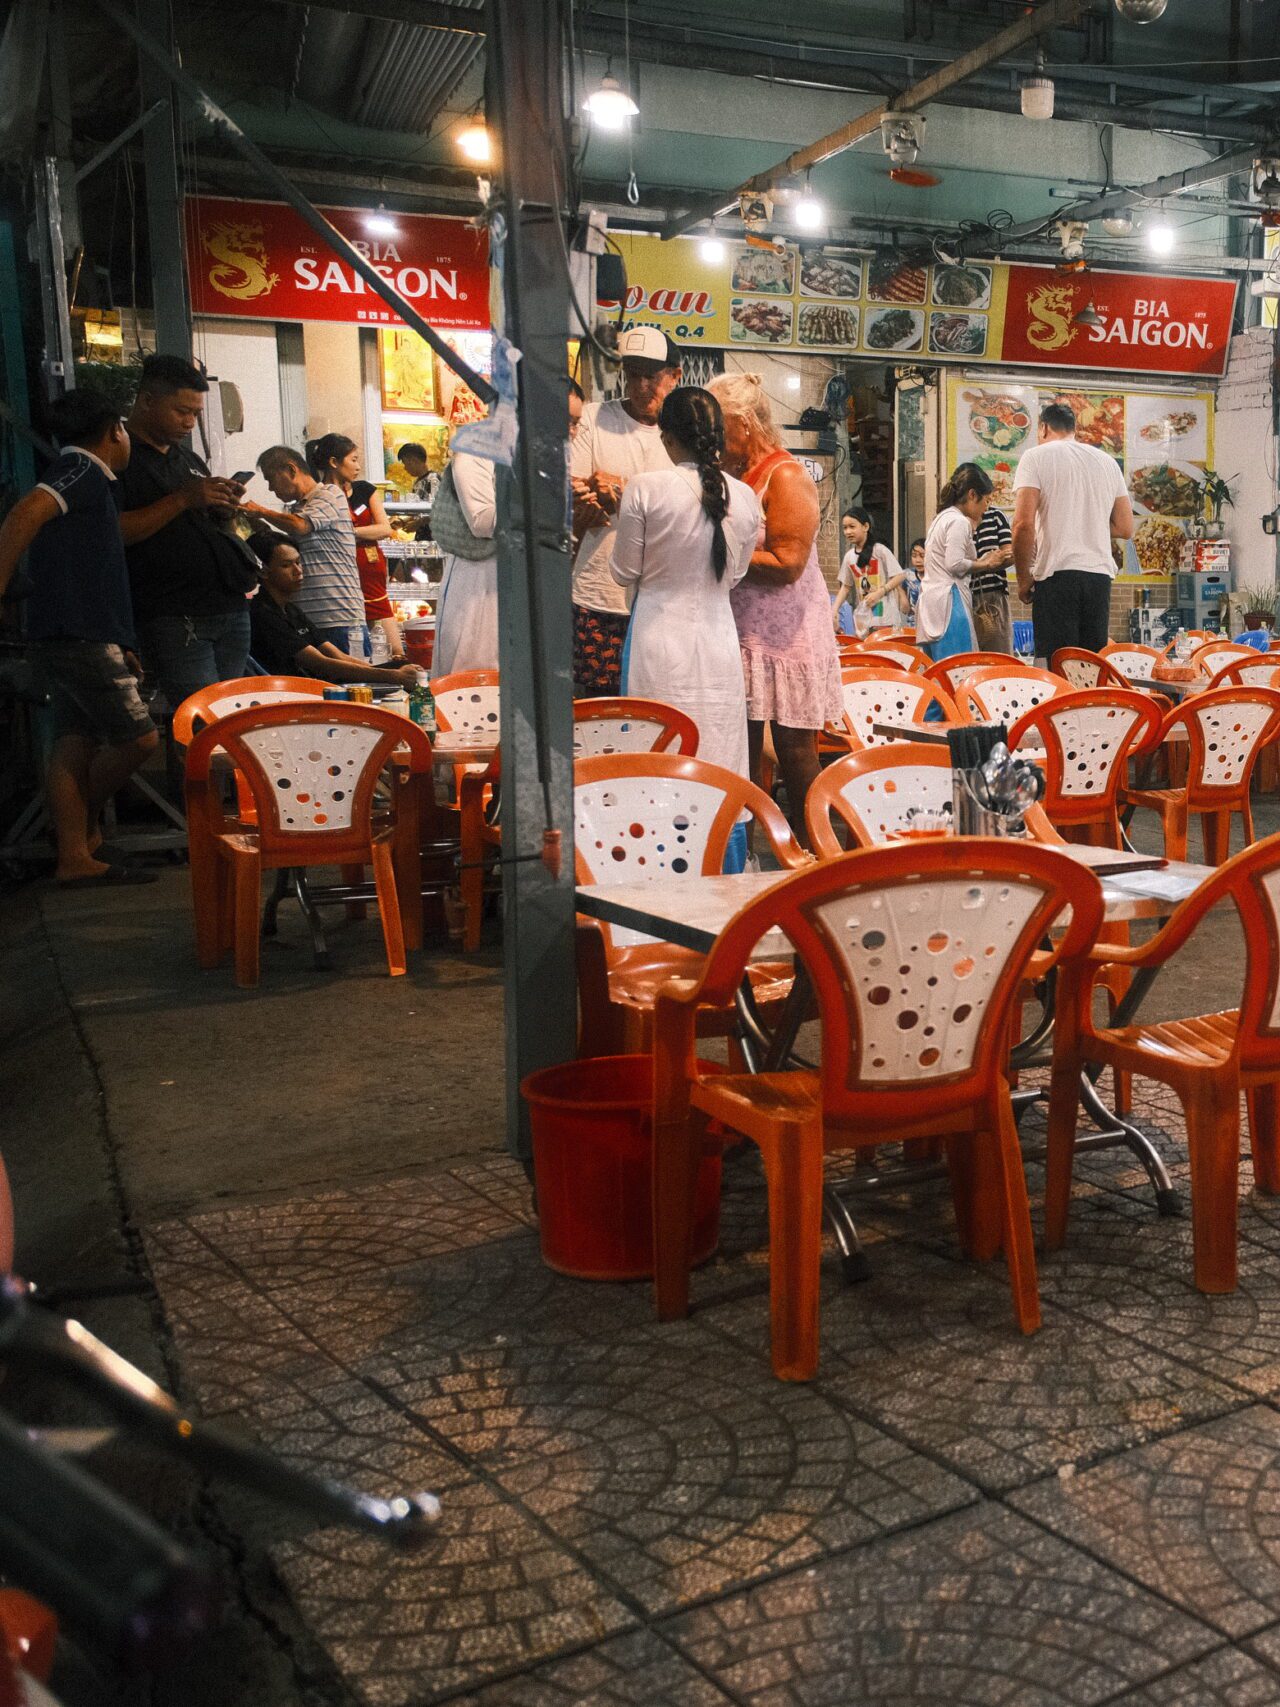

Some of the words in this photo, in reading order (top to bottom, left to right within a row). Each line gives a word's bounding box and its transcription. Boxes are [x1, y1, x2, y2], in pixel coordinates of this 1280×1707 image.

[351, 240, 401, 262] BIA
[436, 256, 452, 264] 1875
[294, 258, 457, 300] SAIGON
[597, 286, 716, 317] oan
[1133, 299, 1170, 318] BIA
[675, 325, 705, 337] Q.4
[1088, 315, 1209, 349] SAIGON
